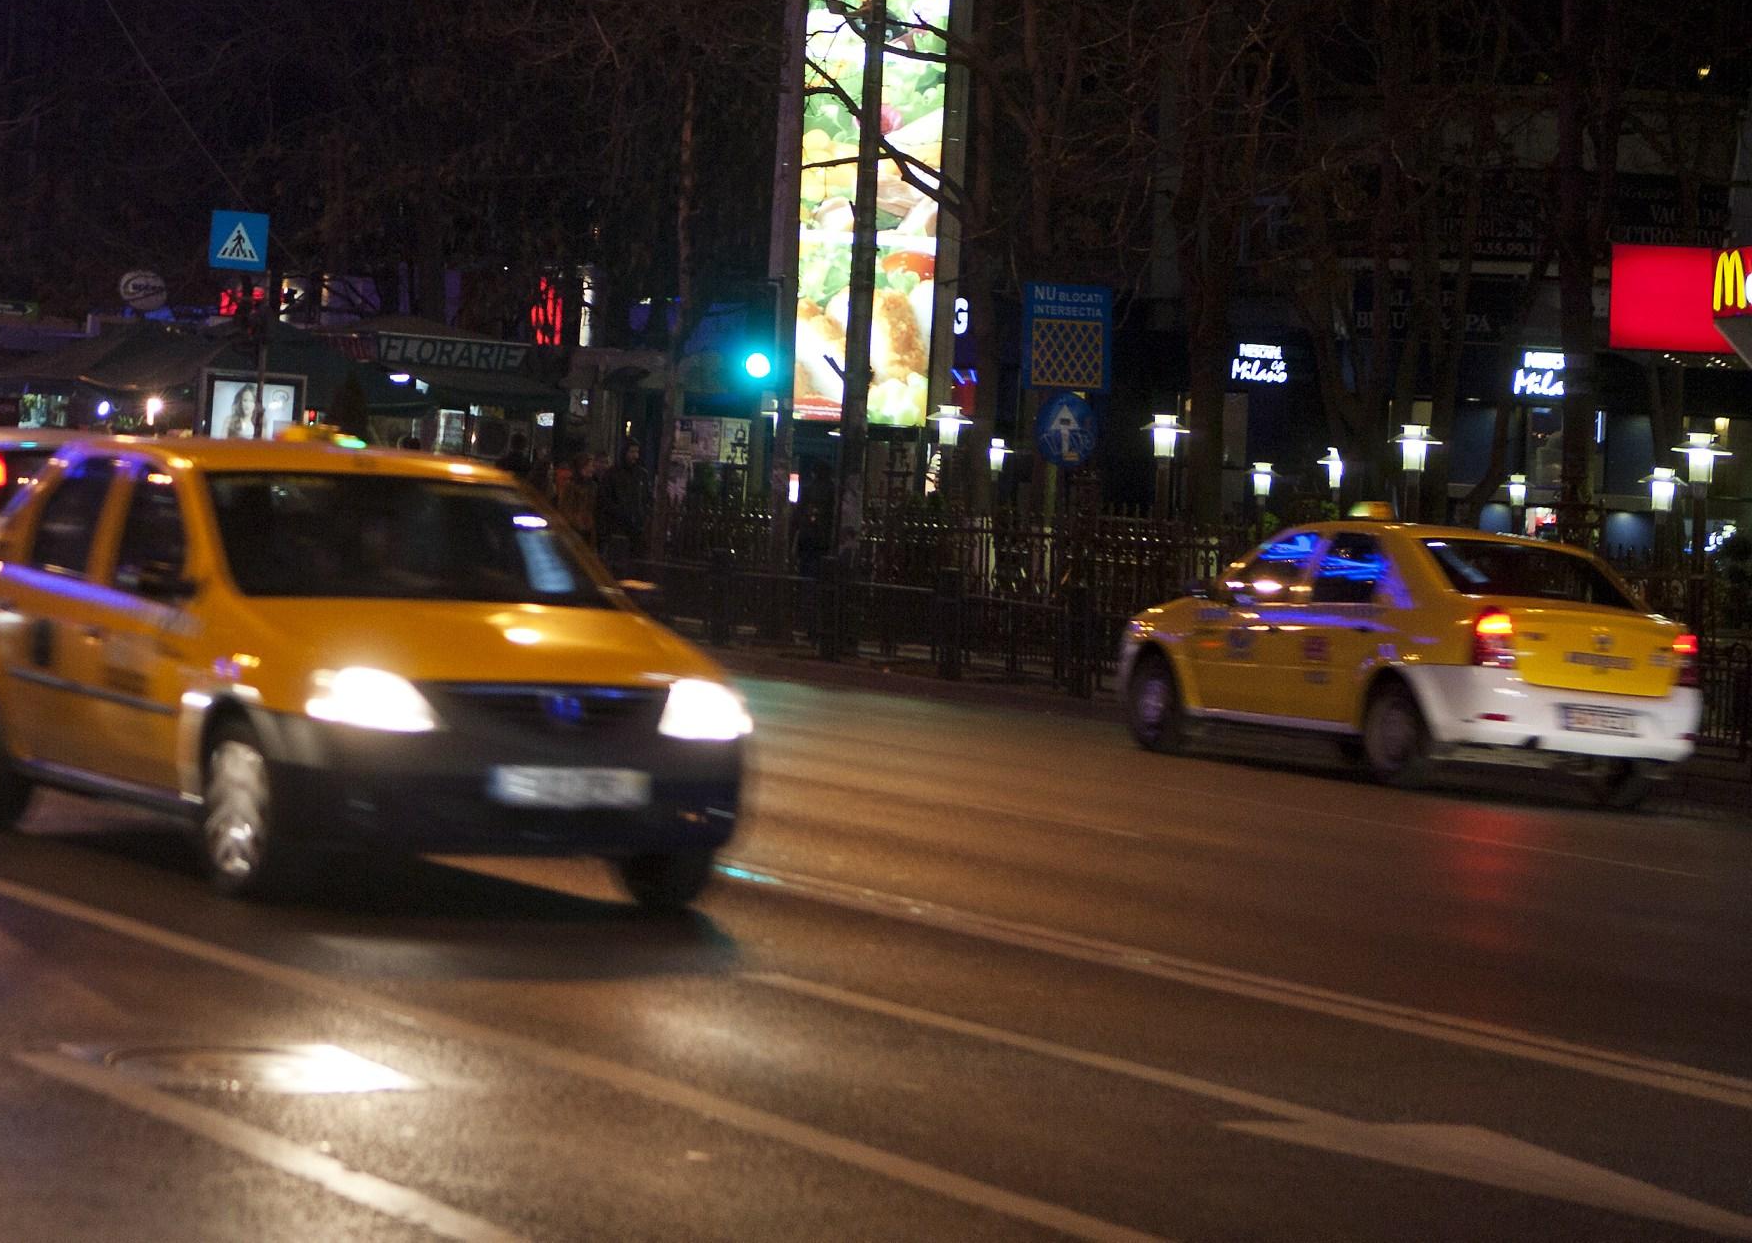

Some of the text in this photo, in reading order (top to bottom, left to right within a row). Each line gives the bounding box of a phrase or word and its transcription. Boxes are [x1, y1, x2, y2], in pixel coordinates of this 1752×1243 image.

[1034, 285, 1056, 301] NU
[381, 336, 529, 373] FLORARIE
[1514, 369, 1564, 396] Mila
